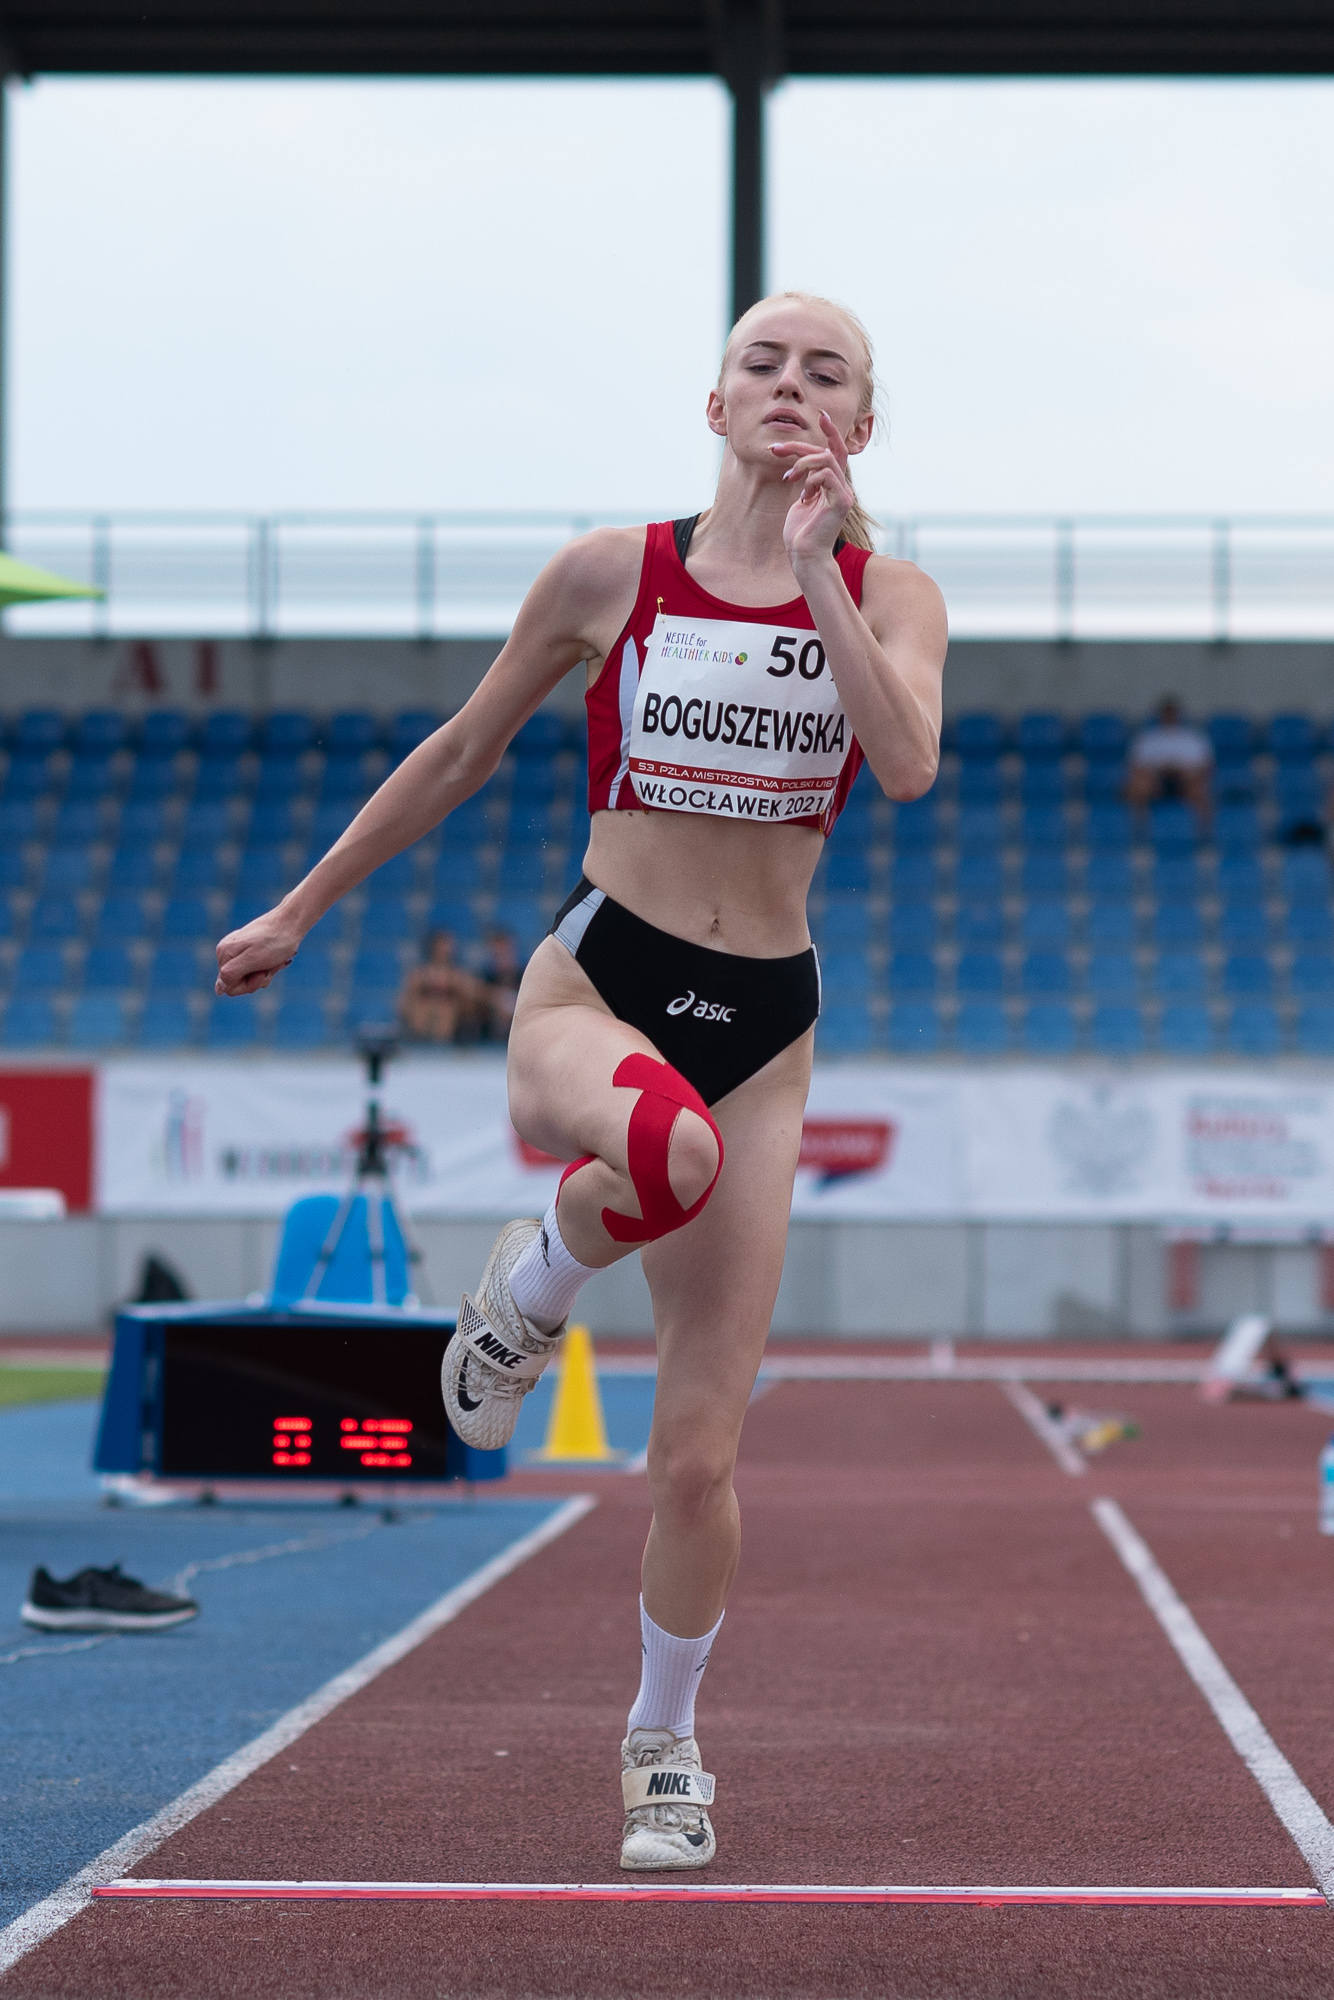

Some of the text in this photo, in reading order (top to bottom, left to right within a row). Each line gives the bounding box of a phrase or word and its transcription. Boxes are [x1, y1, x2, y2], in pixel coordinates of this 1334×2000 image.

[661, 646, 733, 664] HEALTHIER KIDS
[665, 632, 708, 647] NESTLÉ for
[766, 635, 835, 681] 50
[642, 692, 845, 754] BOGUSZEWSKA
[638, 762, 833, 790] 53. PZLA MISTRZOSTWA POLSKI U18
[639, 781, 825, 818] WŁOCŁAWEK 2021
[473, 1331, 529, 1370] NIKE
[646, 1772, 691, 1796] NIKE
